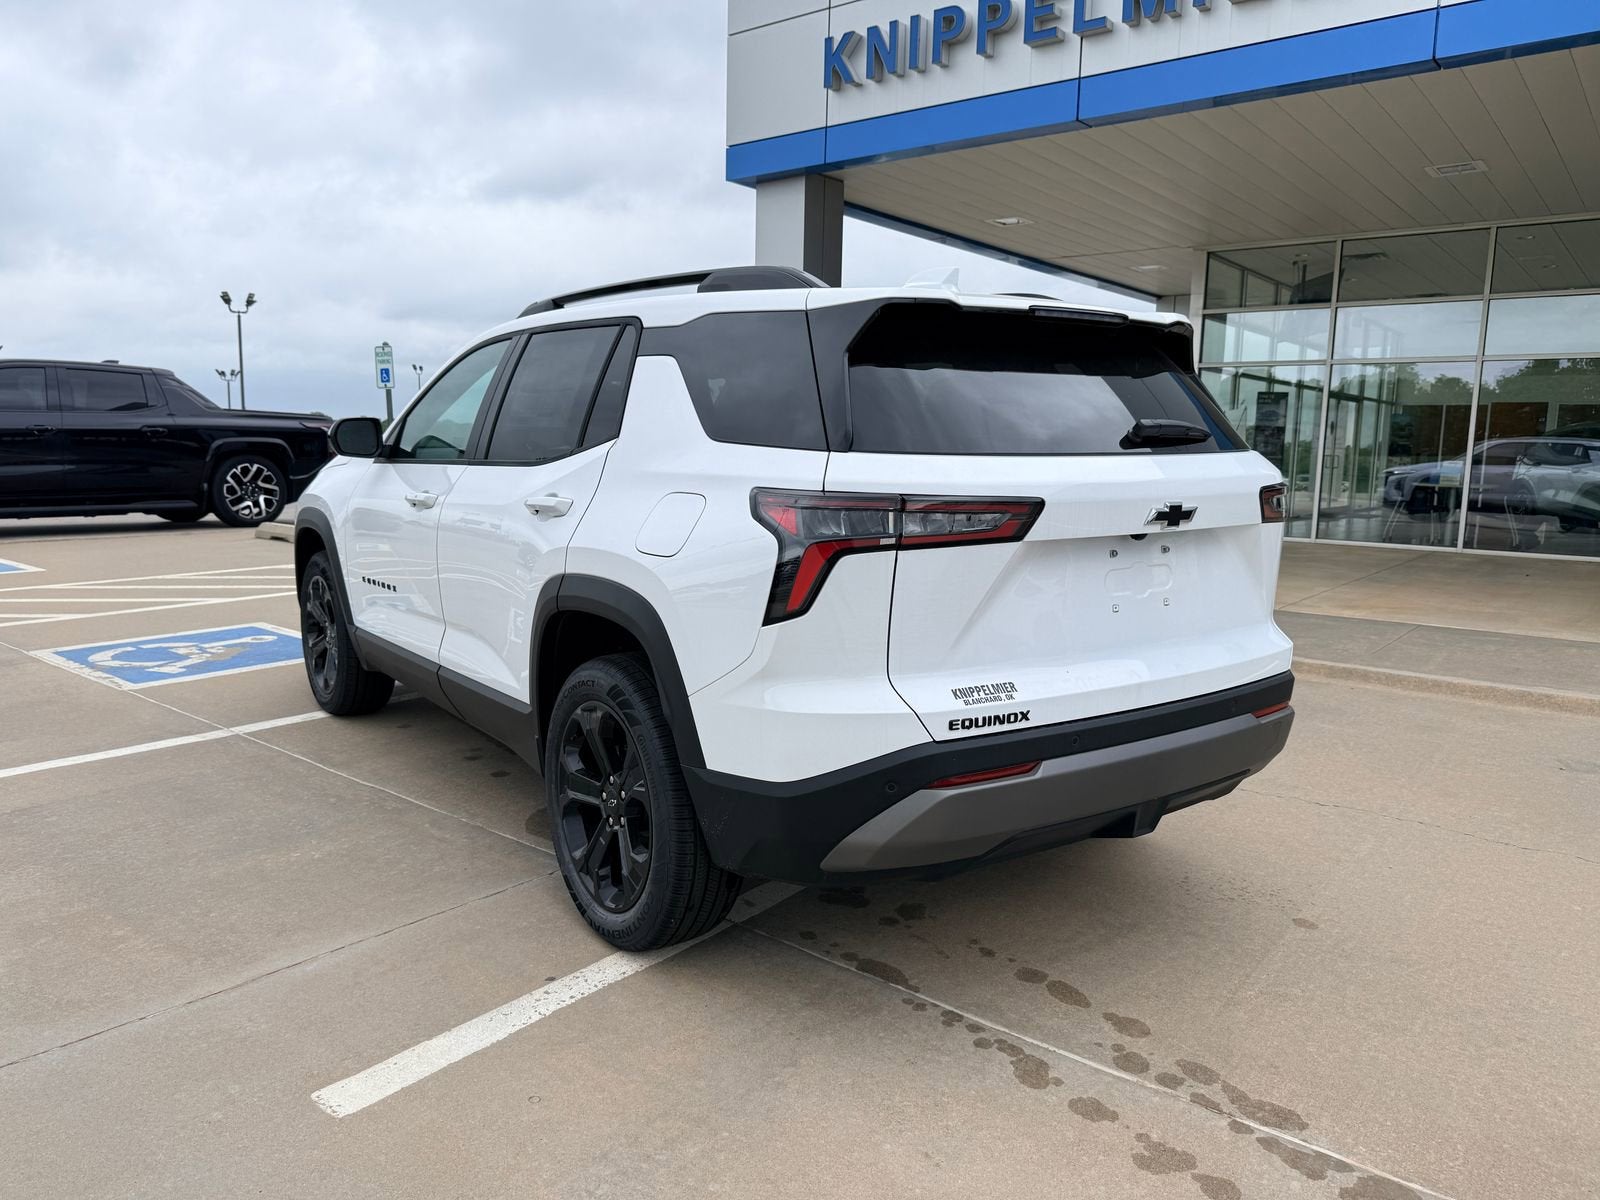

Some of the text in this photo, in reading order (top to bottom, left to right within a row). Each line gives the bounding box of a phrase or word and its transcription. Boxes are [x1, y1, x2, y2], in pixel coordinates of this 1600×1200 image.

[824, 0, 1213, 90] KNIPPEL
[951, 681, 1018, 700] KNIPPELMIER
[1006, 693, 1016, 701] OK
[948, 710, 1031, 731] EQUINOX
